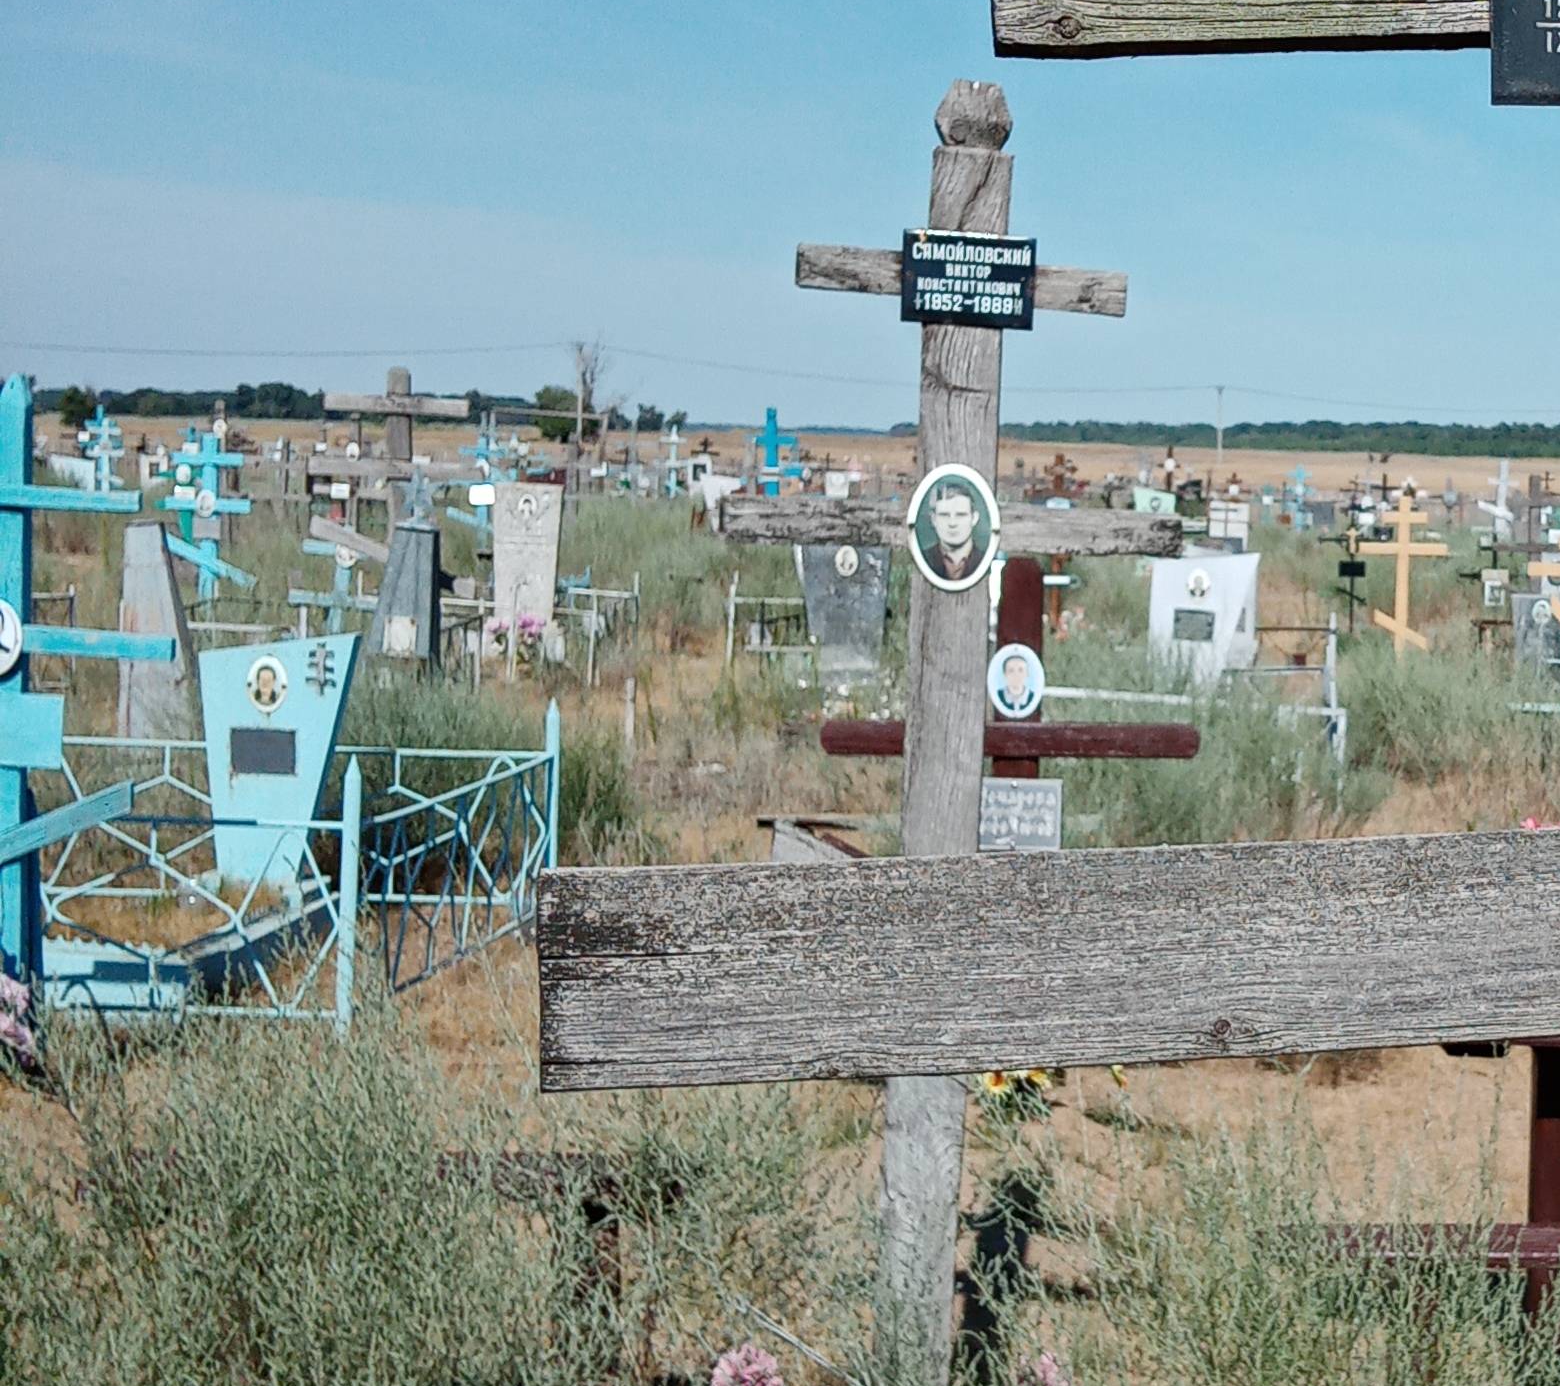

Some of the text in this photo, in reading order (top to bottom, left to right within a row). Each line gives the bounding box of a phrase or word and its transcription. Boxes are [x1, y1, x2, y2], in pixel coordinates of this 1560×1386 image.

[911, 240, 1032, 266] САМОЙЛОВСКИЙ
[945, 263, 993, 280] ВИКТОР
[916, 276, 1022, 297] КОНСТАНТИНОВИЧ
